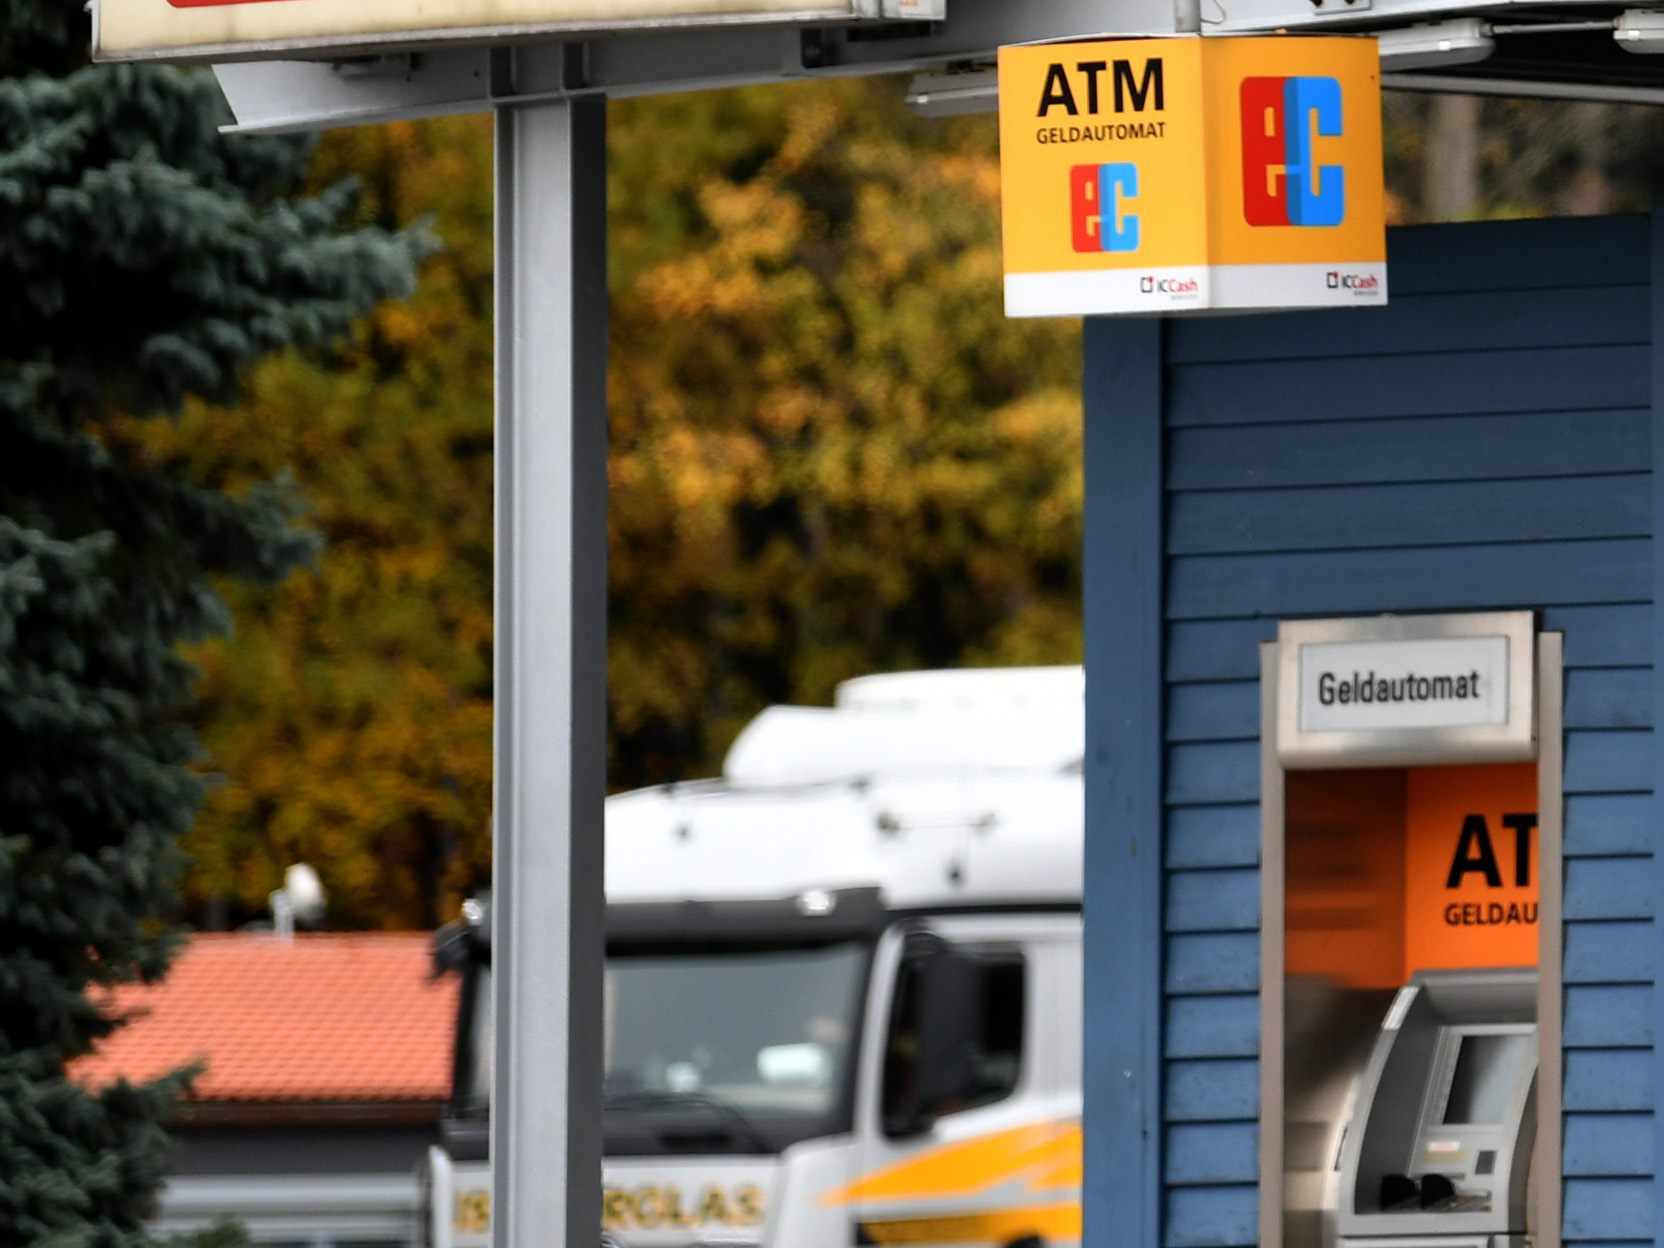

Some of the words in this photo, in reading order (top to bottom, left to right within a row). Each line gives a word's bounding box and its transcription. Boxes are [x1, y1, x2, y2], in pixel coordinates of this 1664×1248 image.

[1036, 57, 1165, 118] ATM
[1036, 121, 1166, 144] GELDAUTOMAT
[1318, 670, 1480, 706] Geldautomat
[1446, 813, 1538, 889] AT
[1444, 902, 1538, 927] GELDAU
